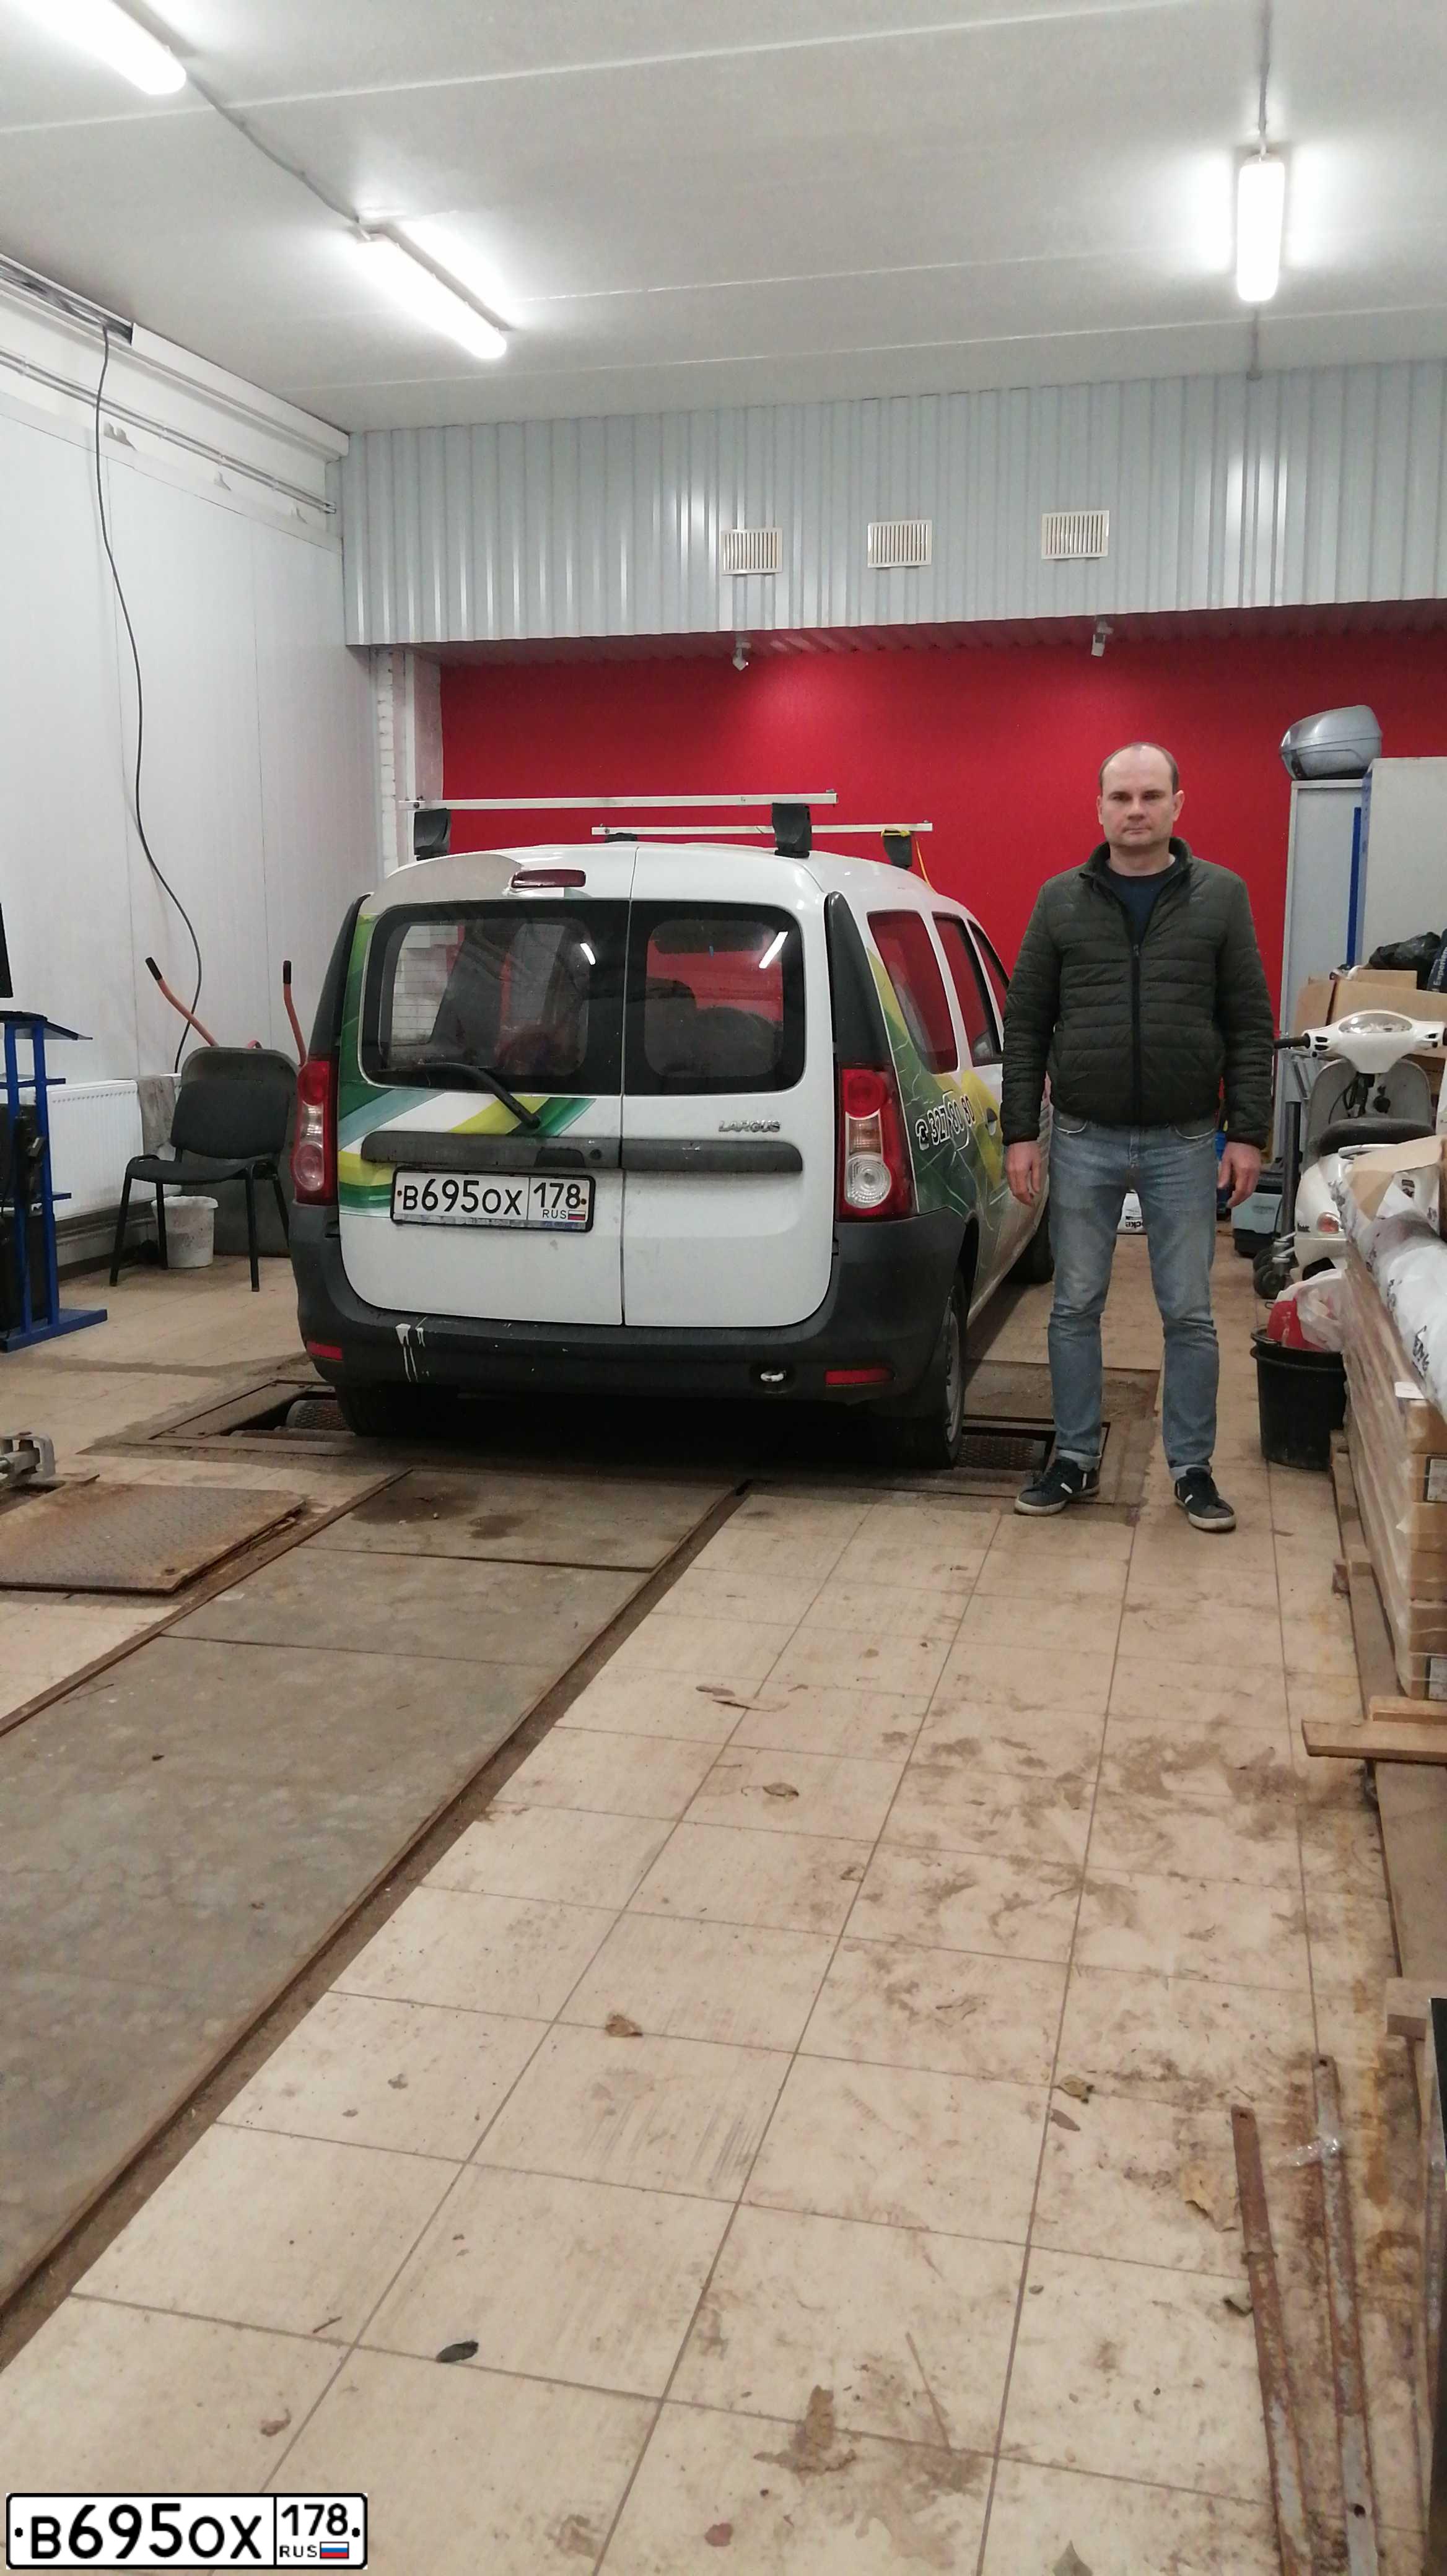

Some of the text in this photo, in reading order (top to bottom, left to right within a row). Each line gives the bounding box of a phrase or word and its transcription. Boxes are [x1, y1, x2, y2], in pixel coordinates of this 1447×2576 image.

[719, 1120, 780, 1133] LARGUS
[533, 1182, 581, 1209] 178
[542, 1209, 567, 1219] RUS
